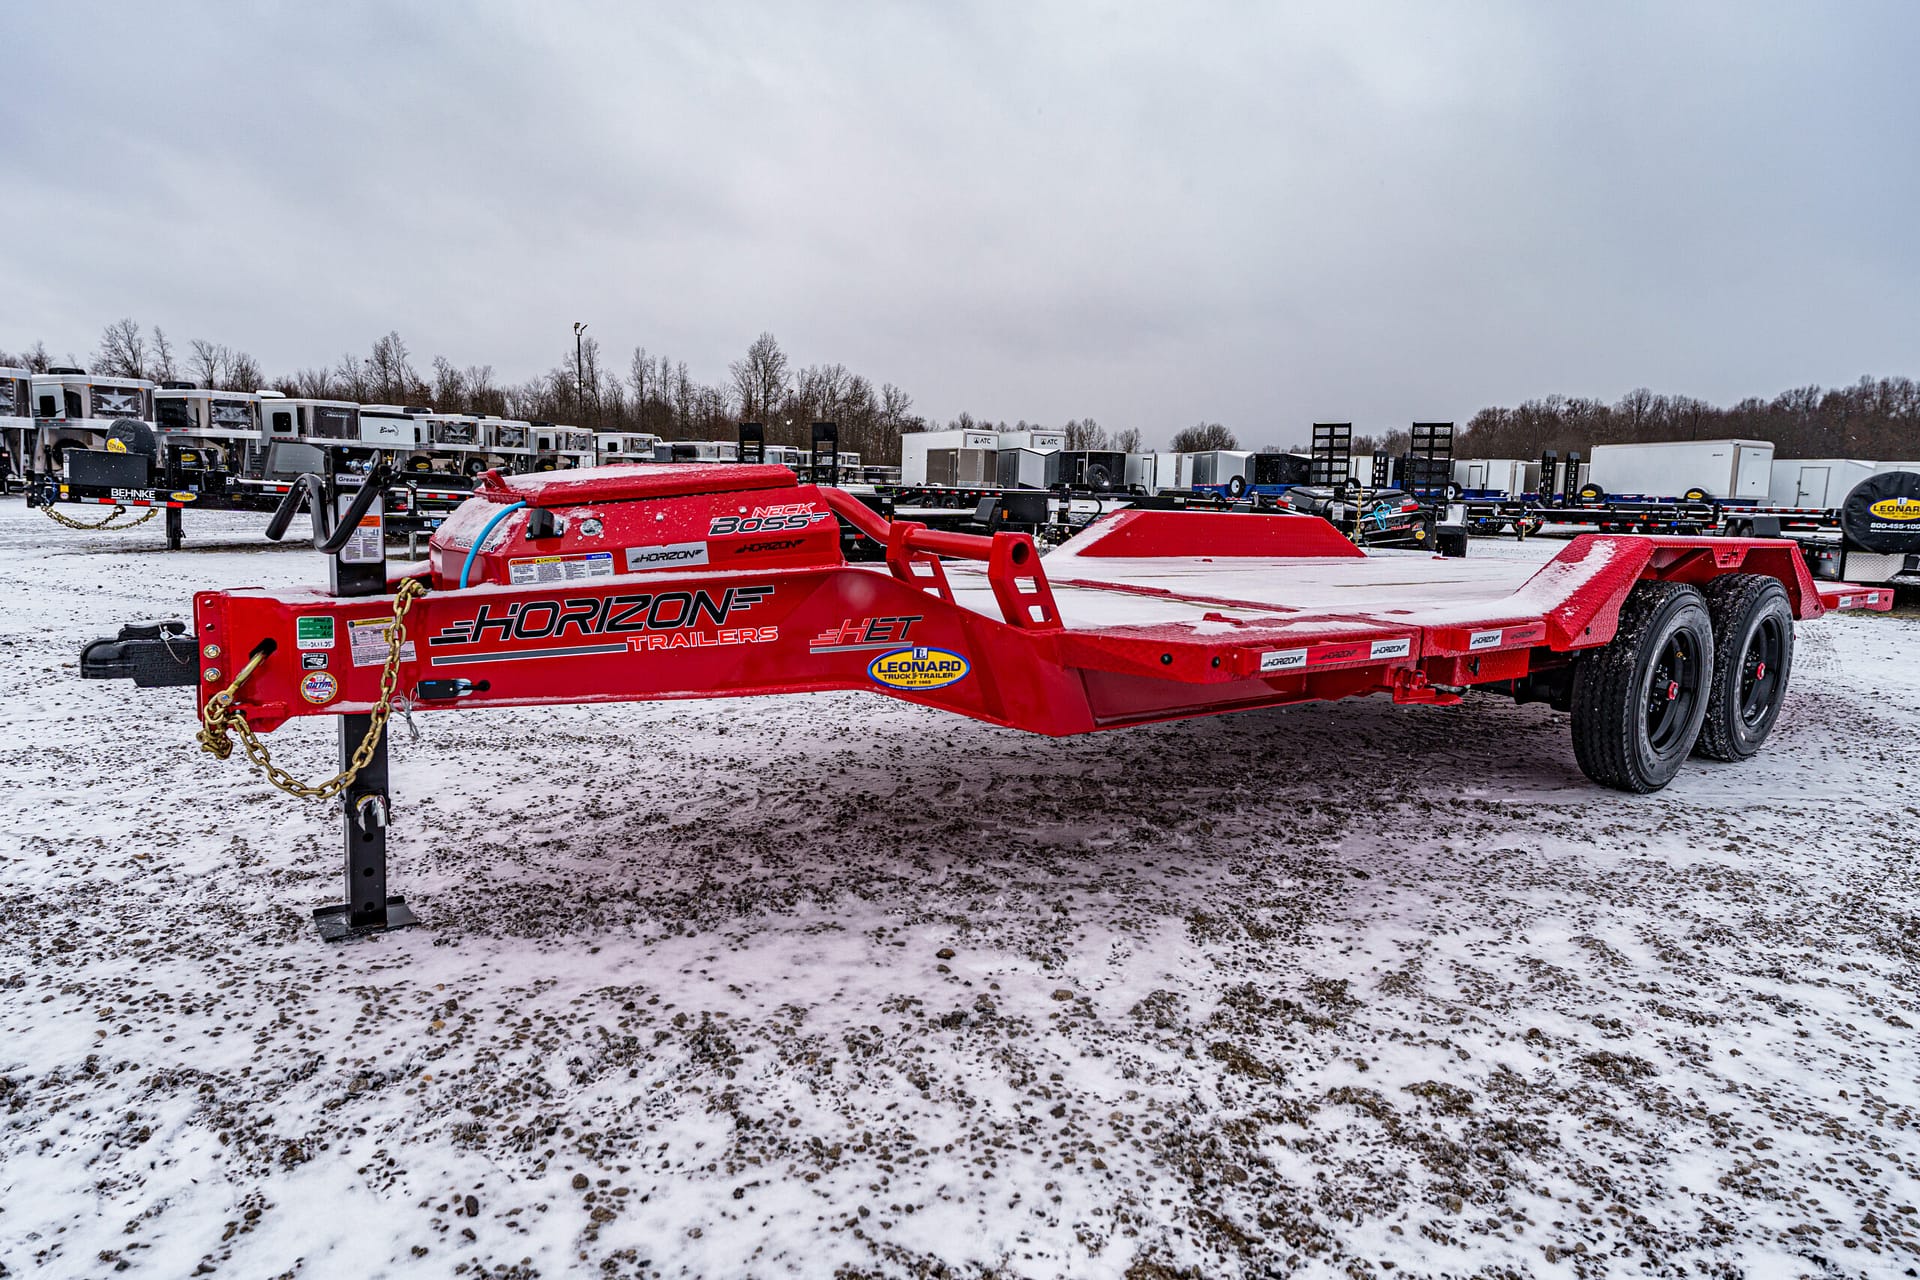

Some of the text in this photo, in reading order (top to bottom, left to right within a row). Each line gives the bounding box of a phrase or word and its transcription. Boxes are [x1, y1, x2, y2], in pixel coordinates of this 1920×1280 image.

[110, 488, 156, 499] BEHNKE
[752, 502, 816, 518] NECK
[708, 514, 812, 536] BOSS
[740, 540, 799, 553] HORIZON
[638, 549, 697, 562] HORIZON
[468, 588, 738, 643] HORIZON
[834, 615, 924, 645] HET
[626, 625, 779, 652] TRAILERS
[1376, 645, 1403, 655] HORIZON
[877, 660, 962, 673] LEONARD
[1266, 655, 1300, 666] HORIZON
